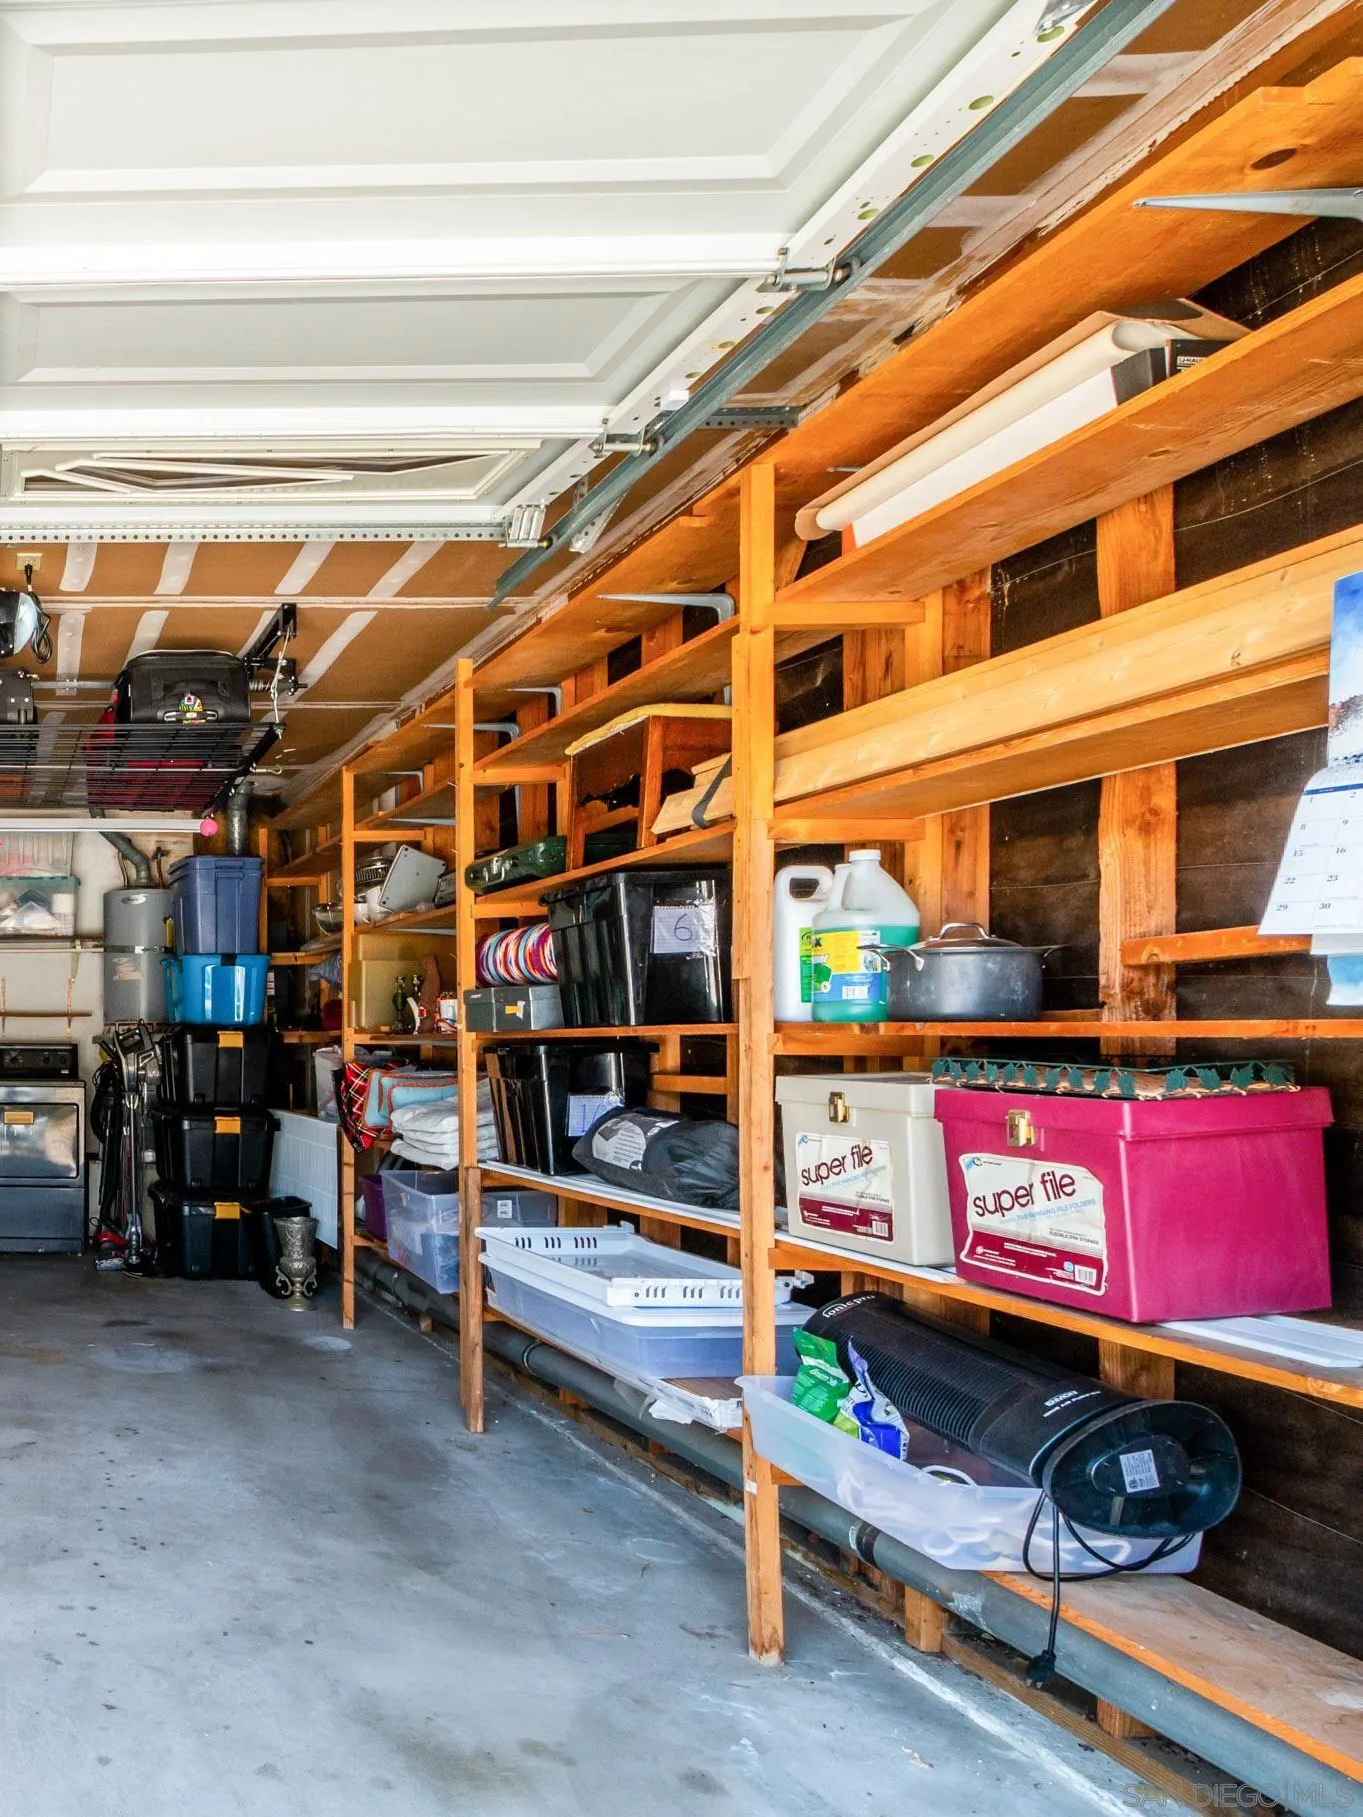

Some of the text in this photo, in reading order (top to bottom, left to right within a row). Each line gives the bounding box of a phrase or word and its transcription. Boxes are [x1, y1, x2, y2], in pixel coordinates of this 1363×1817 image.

[674, 913, 693, 941] 6
[801, 1154, 847, 1186] super
[850, 1143, 873, 1170] file
[973, 1170, 1077, 1218] super file
